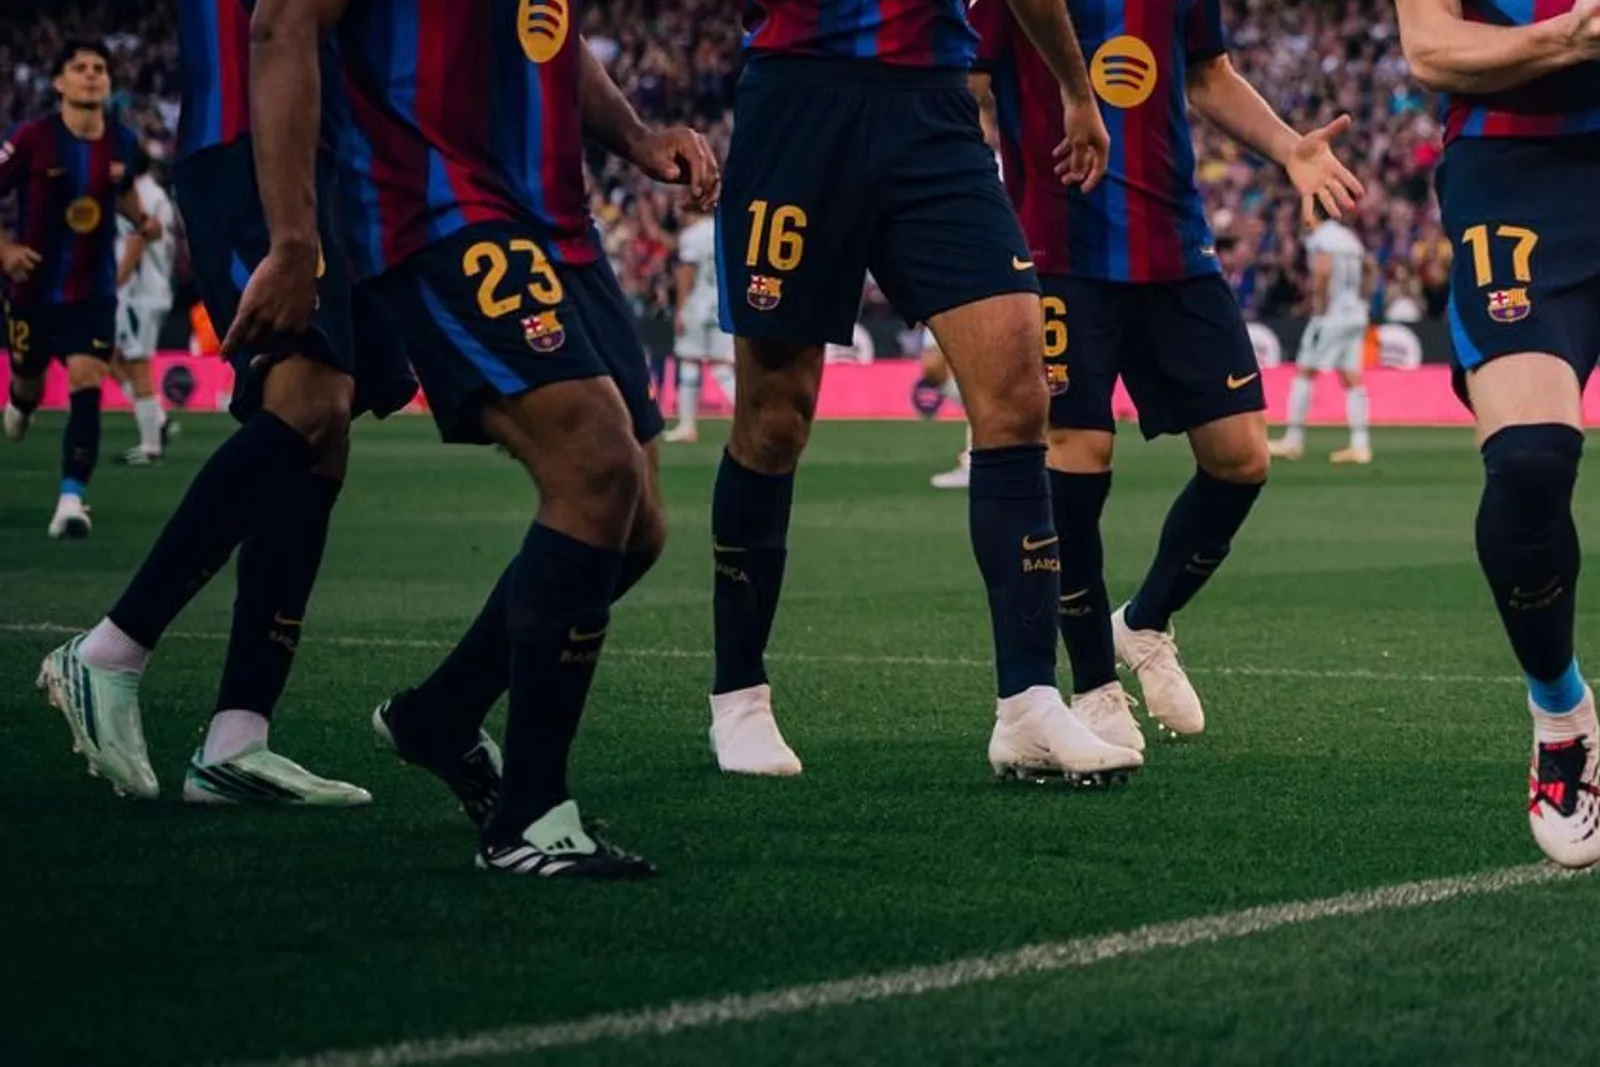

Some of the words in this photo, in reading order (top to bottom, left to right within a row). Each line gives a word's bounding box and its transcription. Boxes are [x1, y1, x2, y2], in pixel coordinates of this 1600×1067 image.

[746, 199, 808, 271] 16
[1461, 224, 1539, 288] 17
[463, 239, 564, 318] 23
[1040, 295, 1068, 358] 6
